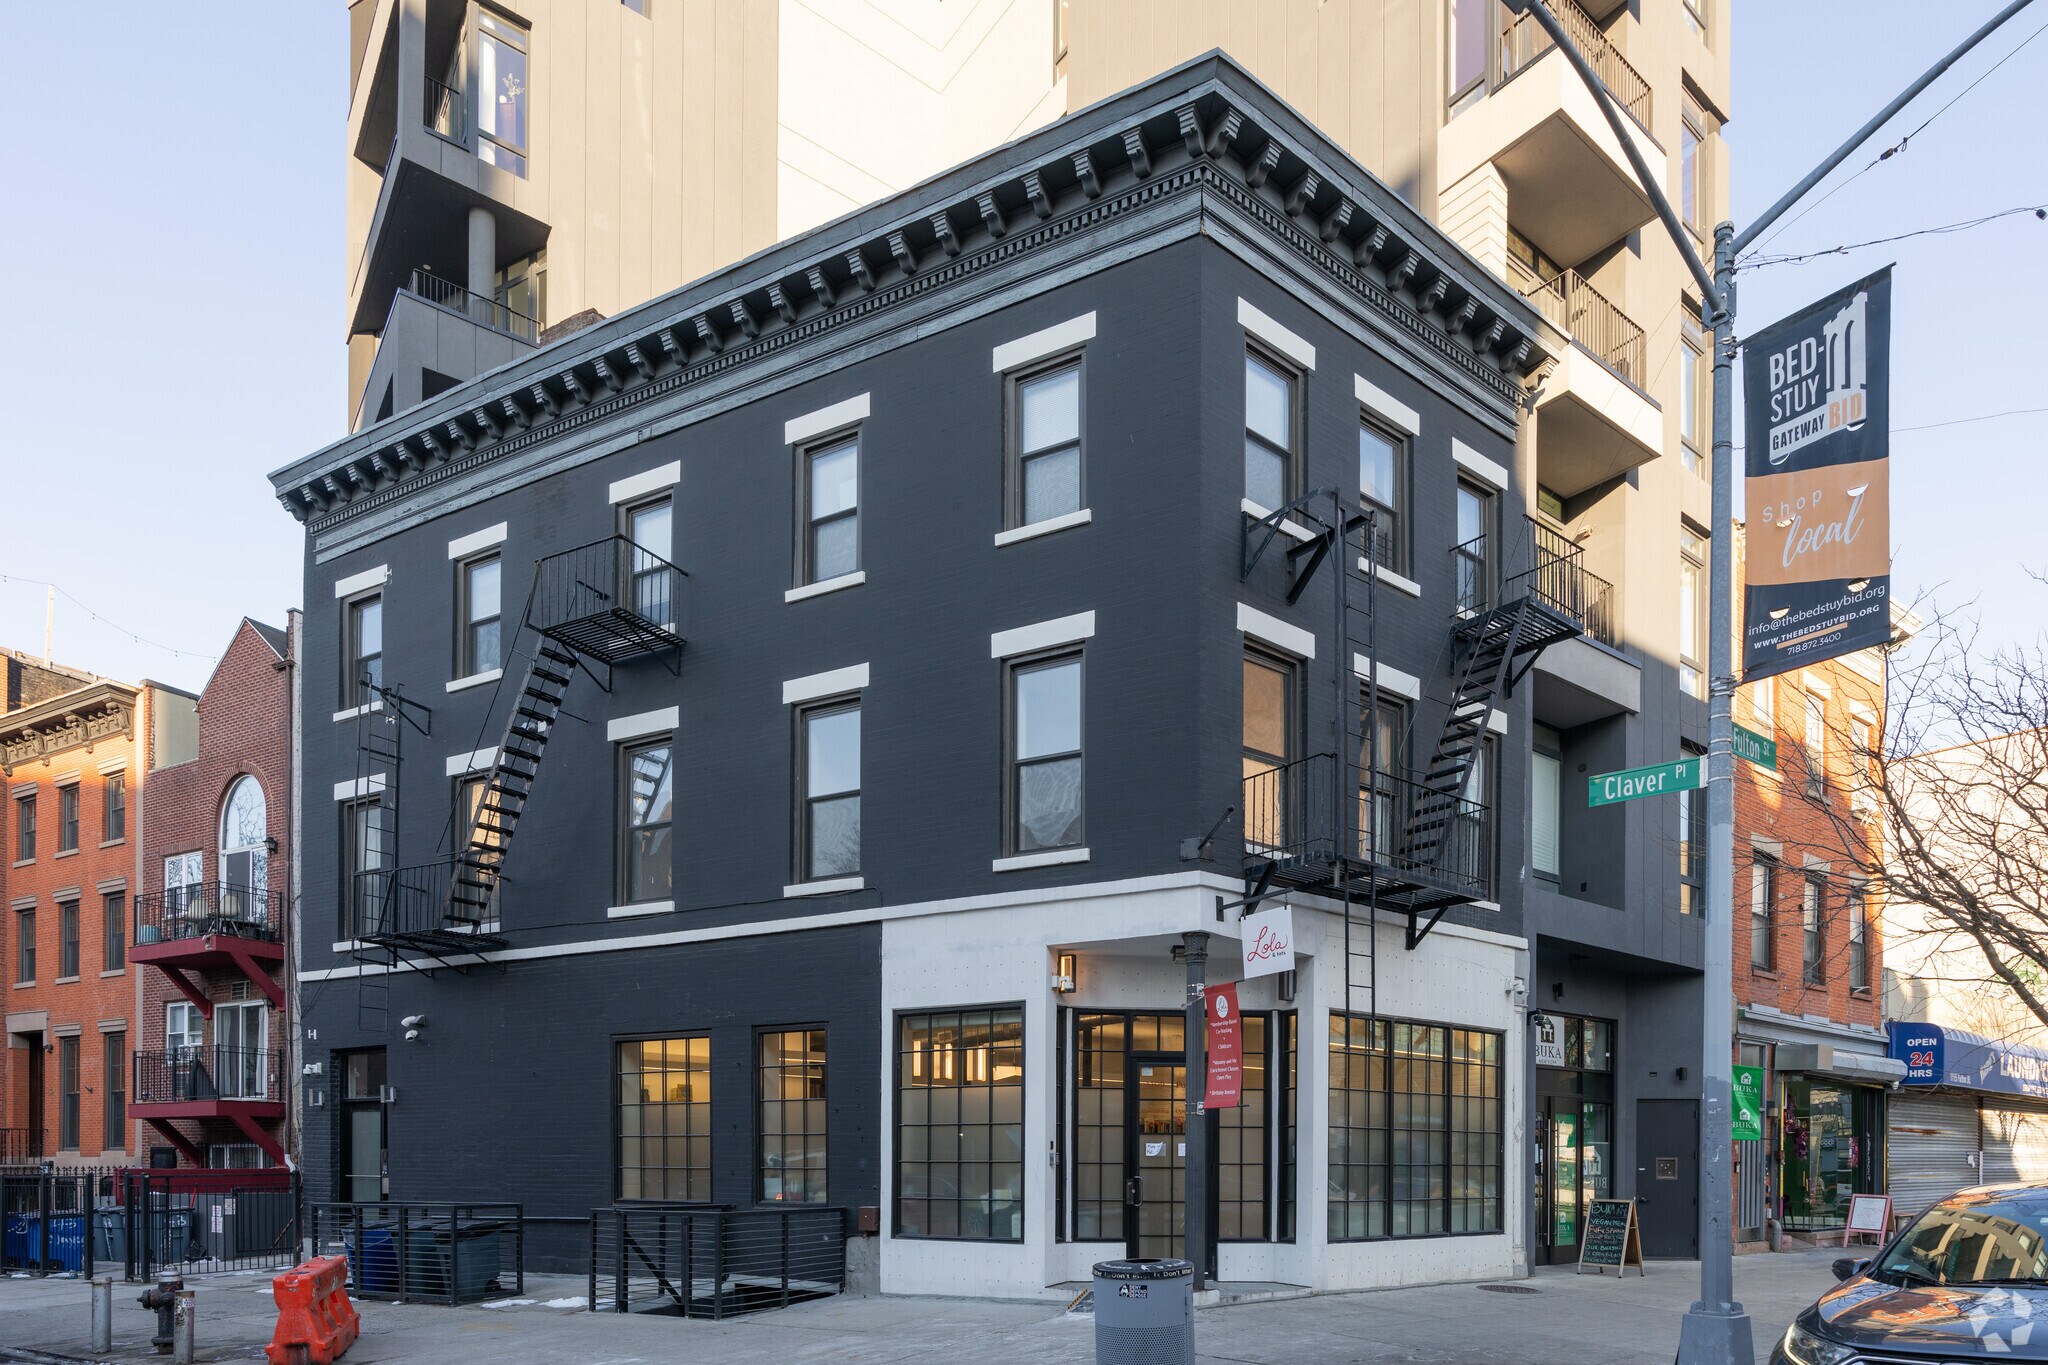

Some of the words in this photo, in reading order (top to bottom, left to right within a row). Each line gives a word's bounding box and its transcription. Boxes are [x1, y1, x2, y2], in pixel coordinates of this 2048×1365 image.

[1769, 336, 1824, 392] BED-
[1770, 375, 1820, 423] STUY
[1772, 413, 1825, 451] GATEWAY
[1828, 392, 1862, 430] BID
[1762, 489, 1822, 523] shop
[1782, 490, 1865, 568] local
[1749, 584, 1885, 636] info@thebedstuybid.org
[1754, 604, 1880, 649] WWW.THEBEDSTUYBID.ORG
[1787, 632, 1842, 656] 718.872.3400
[1733, 727, 1760, 761] Fulton
[1763, 740, 1770, 757] St
[1604, 771, 1666, 800] Claver
[1675, 764, 1686, 779] Pl
[1247, 925, 1288, 962] Lola
[1536, 1045, 1562, 1059] BUKA
[1907, 1038, 1937, 1047] OPEN
[1910, 1051, 1935, 1067] 24
[1733, 1084, 1758, 1094] BUKA
[1909, 1069, 1933, 1078] HRS
[1732, 1121, 1758, 1129] BUKA
